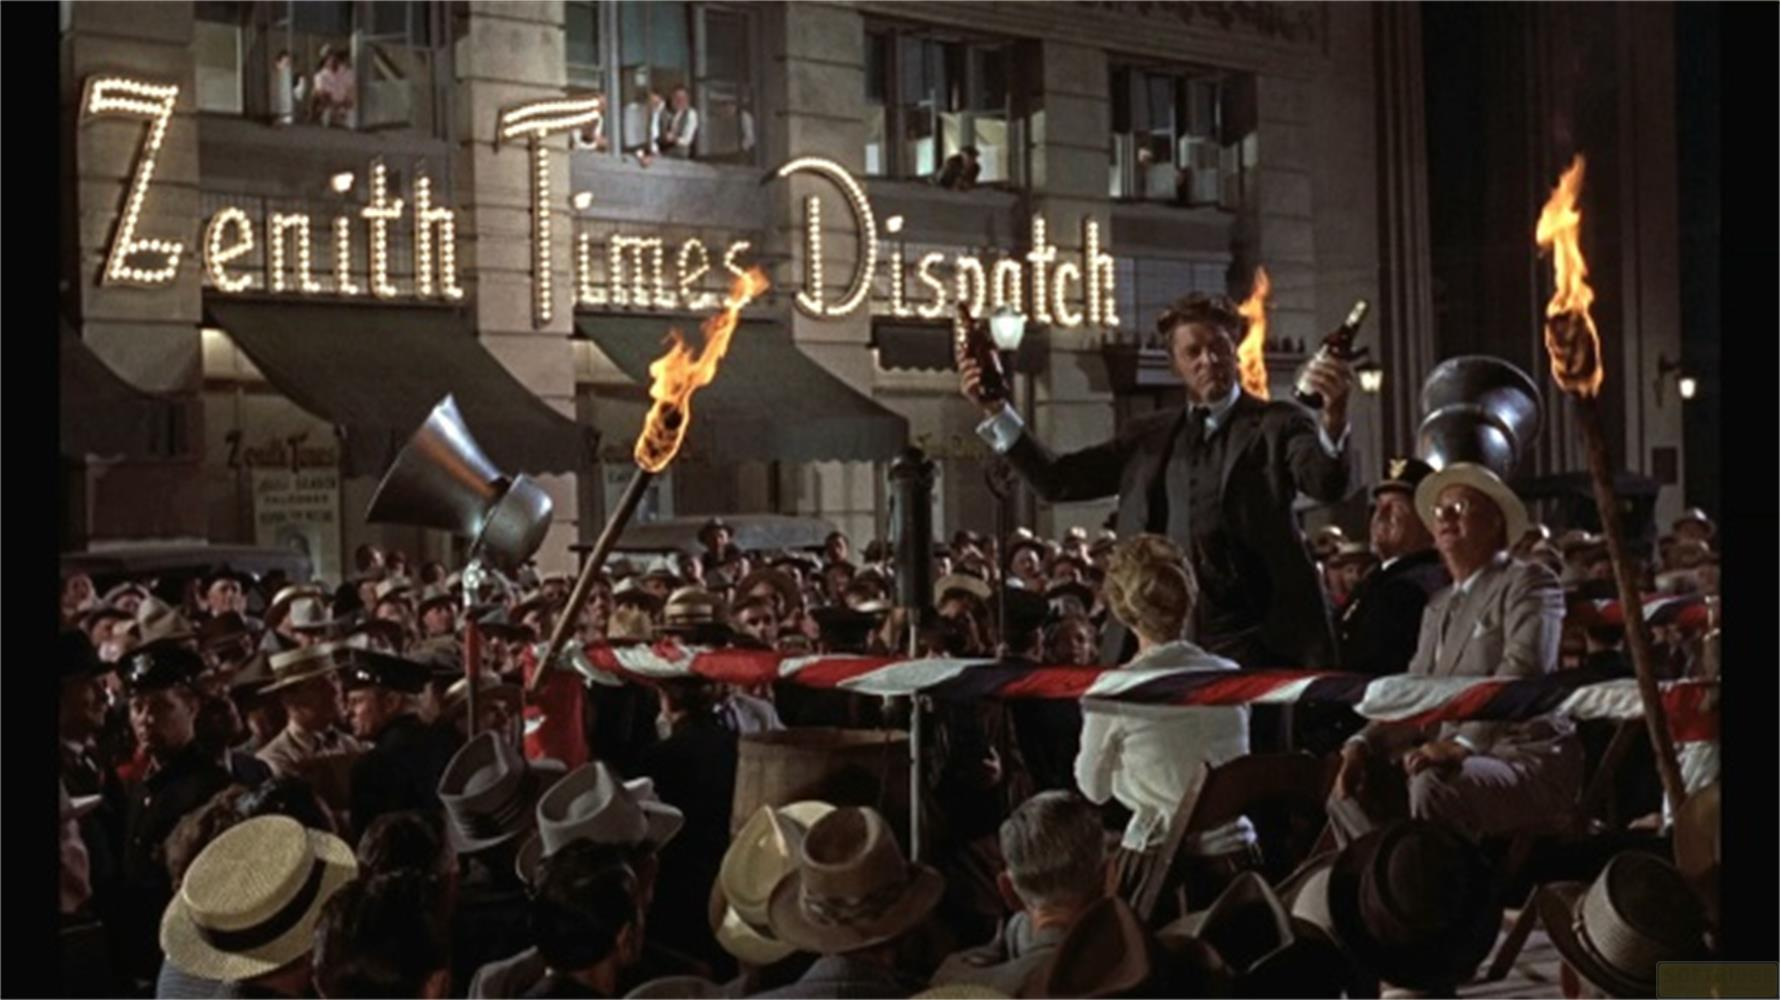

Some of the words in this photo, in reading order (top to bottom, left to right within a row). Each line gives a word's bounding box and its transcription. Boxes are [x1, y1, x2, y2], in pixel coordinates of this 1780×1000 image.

[81, 75, 463, 298] Zenith
[499, 94, 754, 327] Times
[772, 156, 1121, 343] Dispatch
